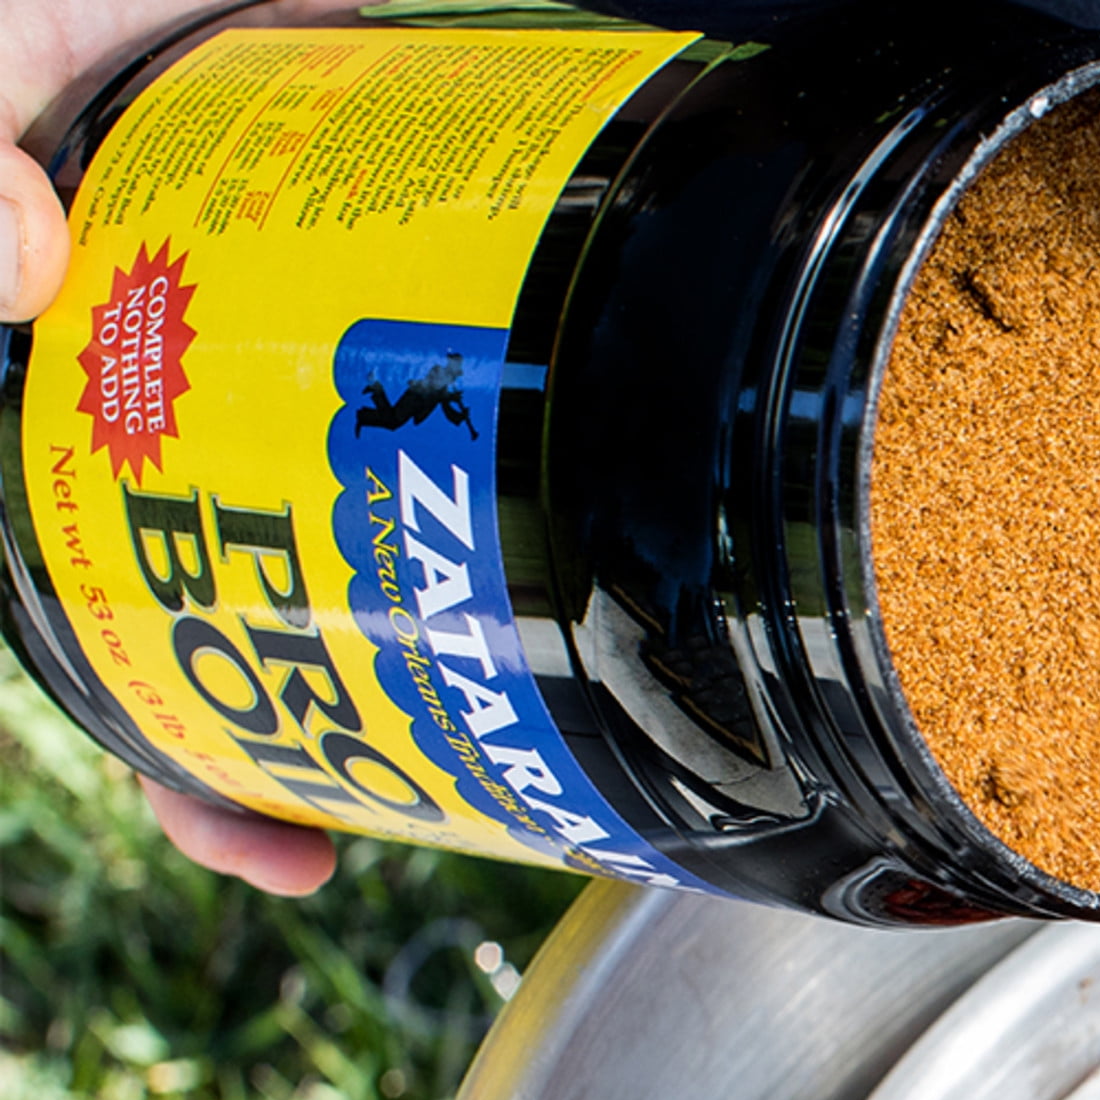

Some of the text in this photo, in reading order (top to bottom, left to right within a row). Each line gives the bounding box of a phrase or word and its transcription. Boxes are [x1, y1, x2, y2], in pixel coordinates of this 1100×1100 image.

[100, 302, 122, 423] TO ADD
[121, 285, 146, 435] NOTHING
[144, 276, 169, 433] COMPLETE
[50, 444, 78, 513] Net
[365, 467, 392, 505] A
[61, 523, 93, 570] wt
[369, 511, 403, 602] New
[80, 583, 114, 624] 53
[101, 628, 131, 668] oz
[121, 478, 380, 822] BOIL
[210, 490, 451, 824] PRO
[389, 606, 456, 732] Orleans
[128, 680, 164, 708] (3
[153, 710, 186, 740] lb
